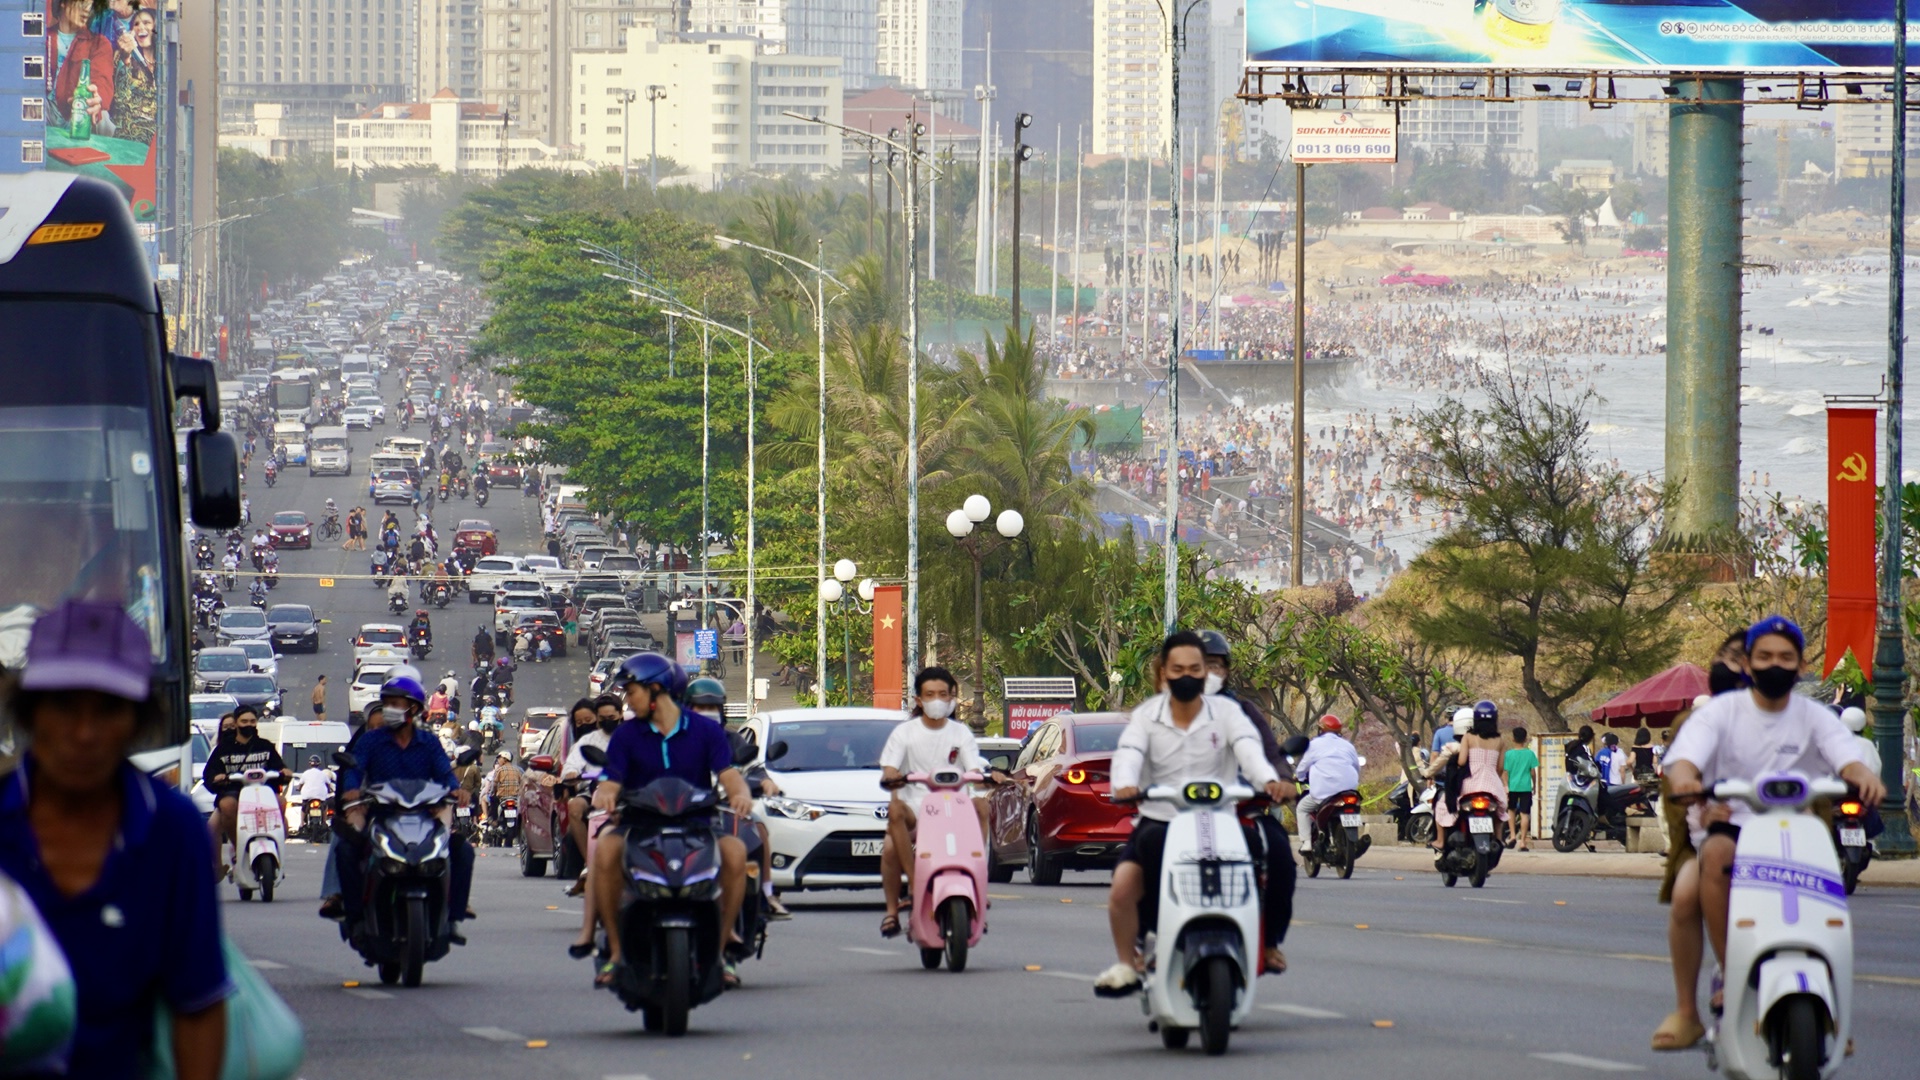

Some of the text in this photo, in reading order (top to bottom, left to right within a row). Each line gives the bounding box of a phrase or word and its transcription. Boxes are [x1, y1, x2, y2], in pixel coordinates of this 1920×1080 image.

[1297, 144, 1391, 154] 0913 069 690
[1757, 867, 1825, 890] CHANEL
